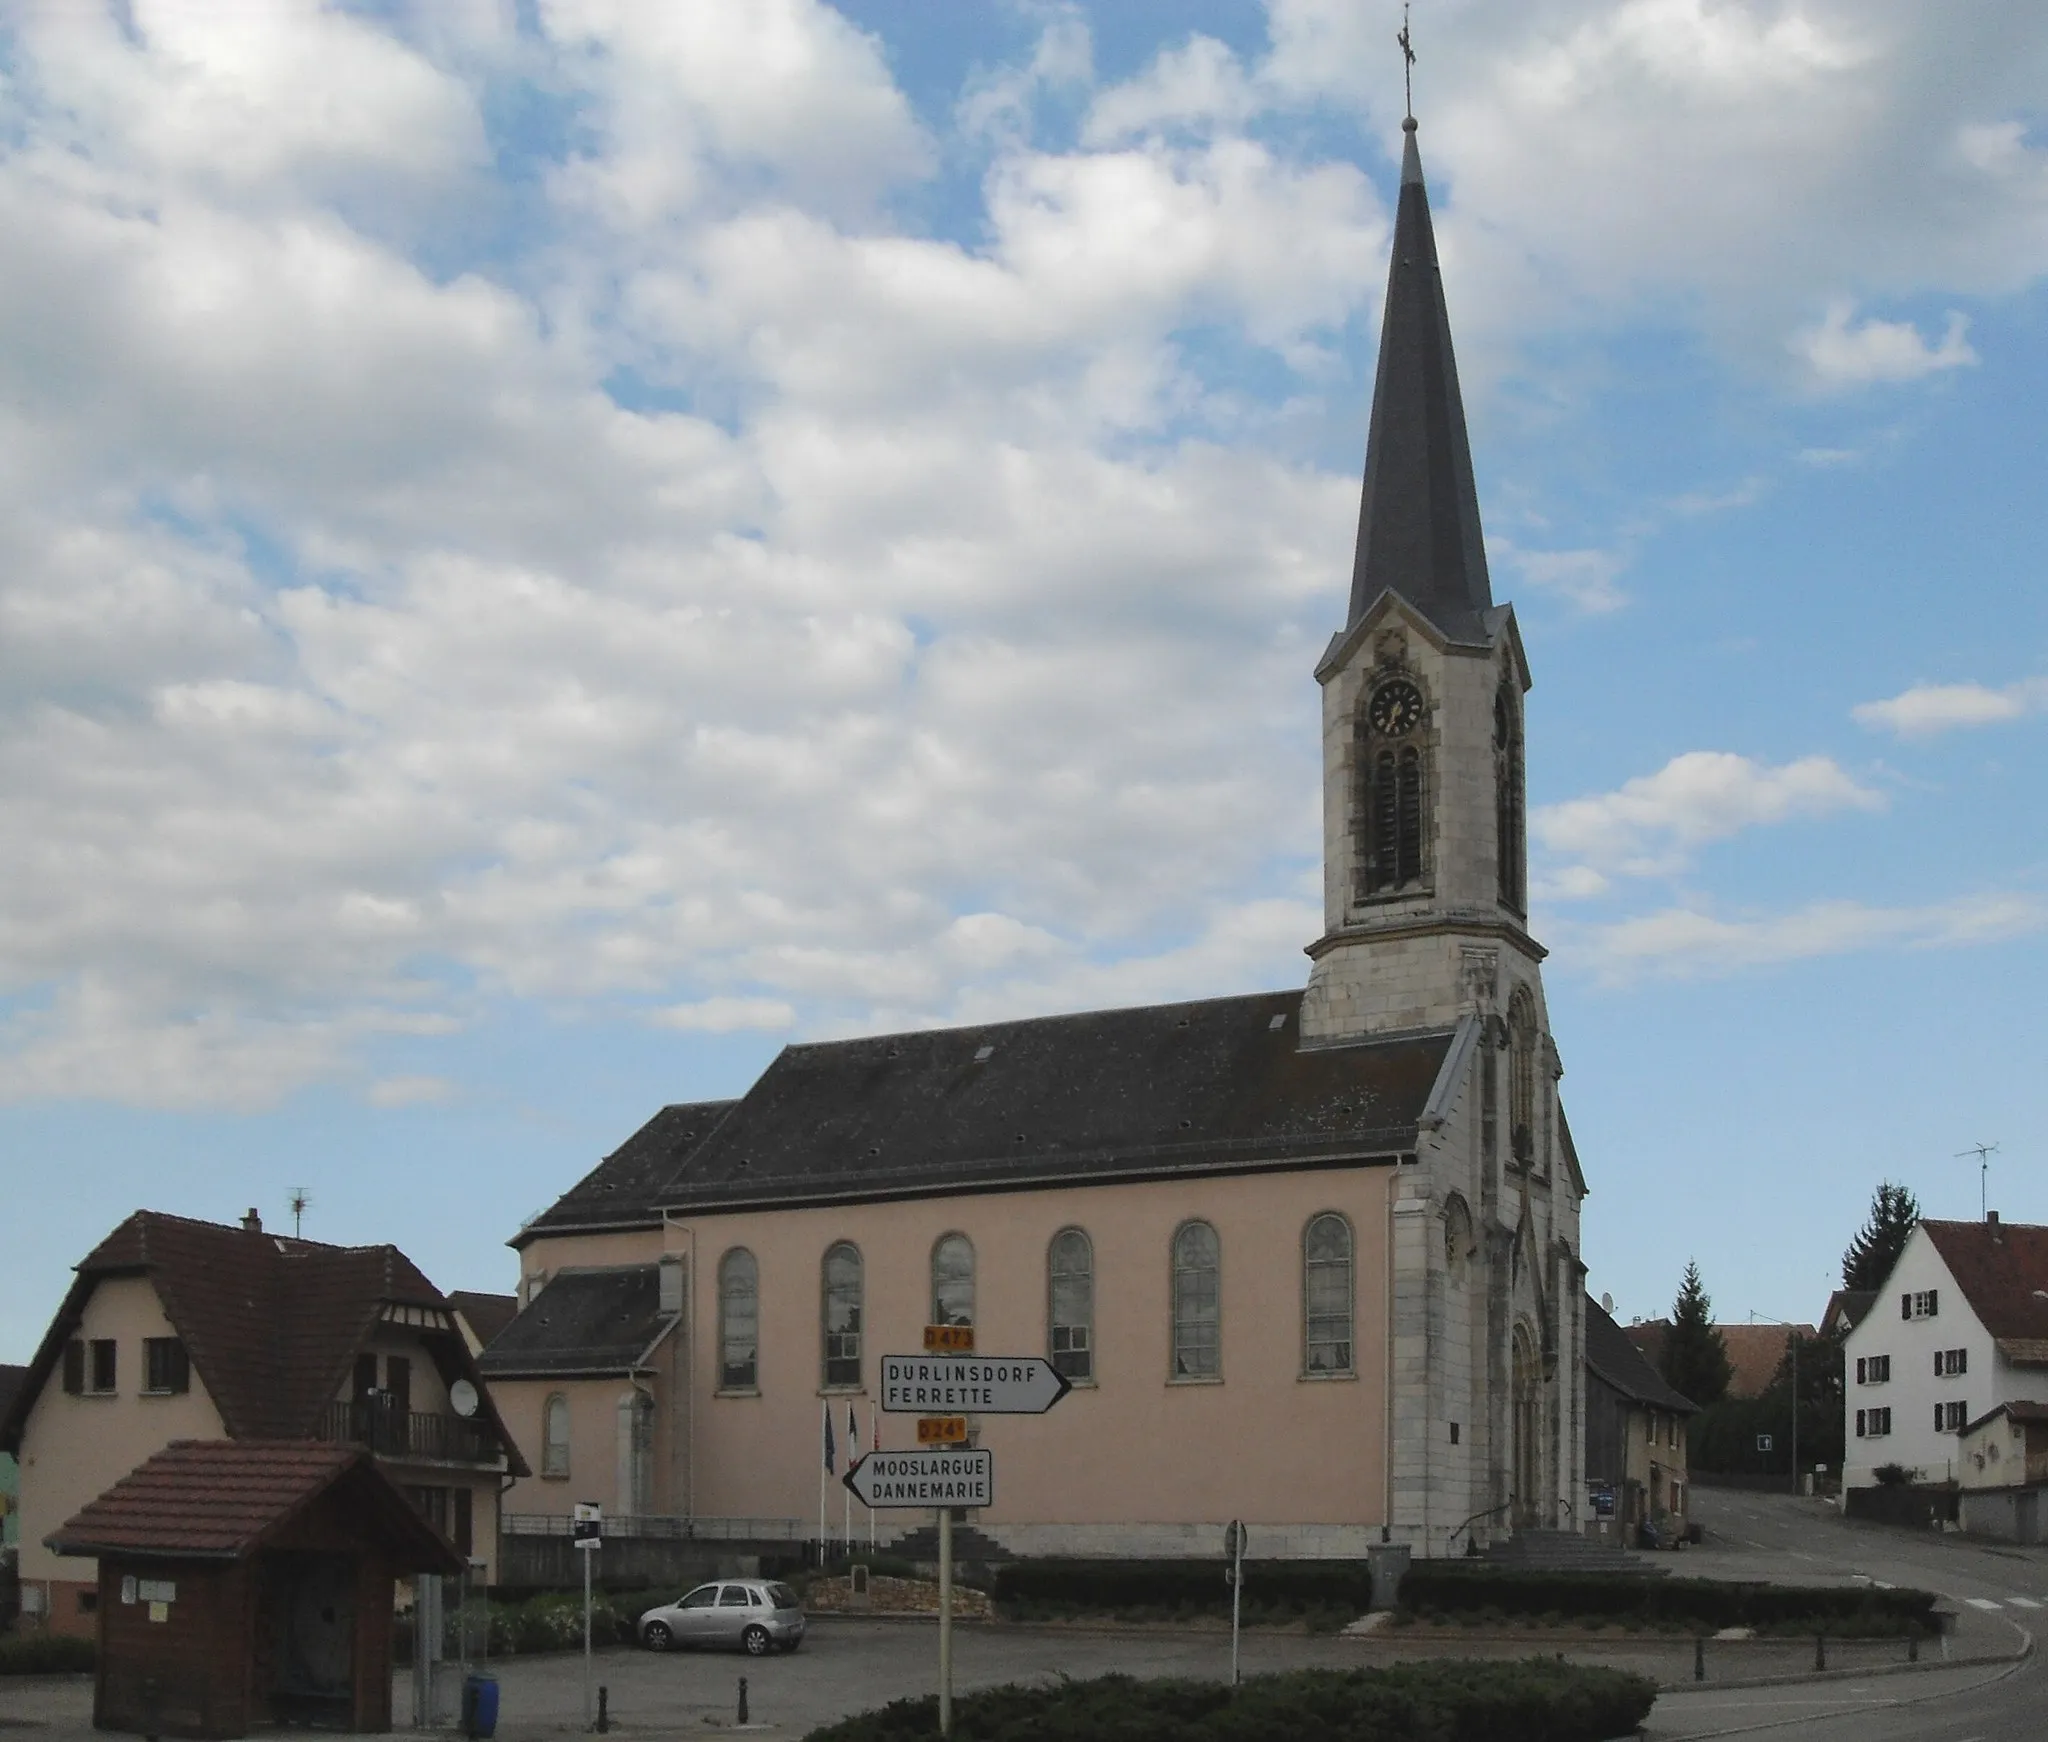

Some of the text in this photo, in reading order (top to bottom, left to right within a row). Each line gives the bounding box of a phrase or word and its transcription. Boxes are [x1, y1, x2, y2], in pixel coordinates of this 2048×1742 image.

[889, 1365, 1036, 1382] DURLINSDORF
[889, 1388, 992, 1404] FERRETTE
[873, 1459, 985, 1476] MOOSLARGUE
[873, 1482, 985, 1499] DANNEMARIE
